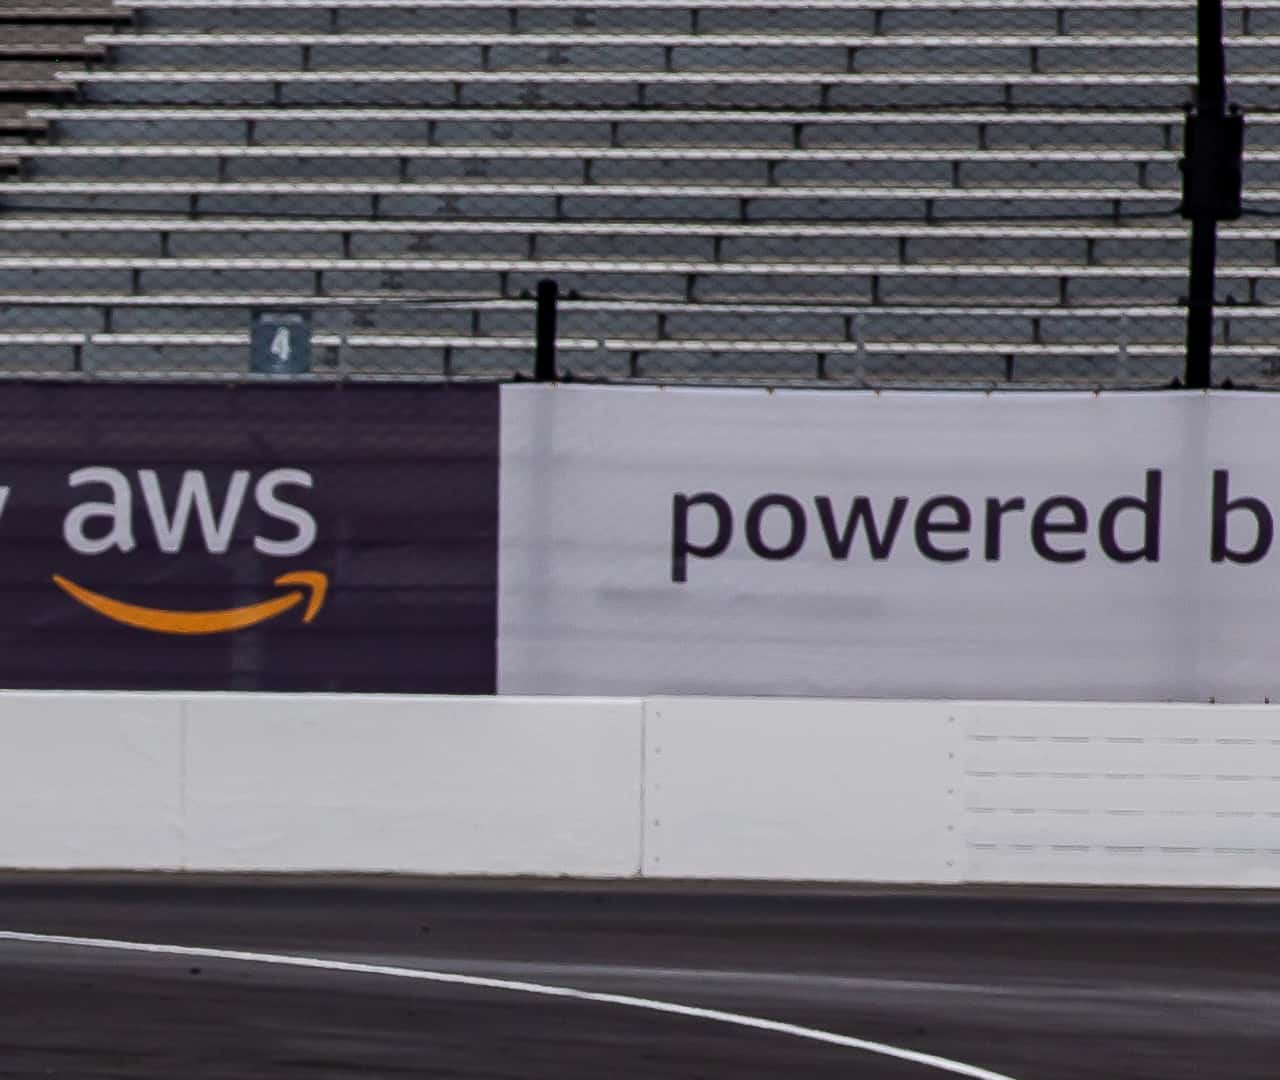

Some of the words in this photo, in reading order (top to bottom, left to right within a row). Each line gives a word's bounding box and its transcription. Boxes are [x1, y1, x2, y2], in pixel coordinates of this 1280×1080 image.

[270, 326, 291, 361] 4
[63, 466, 318, 556] aws
[670, 467, 1163, 584] powered
[1209, 468, 1275, 566] b
